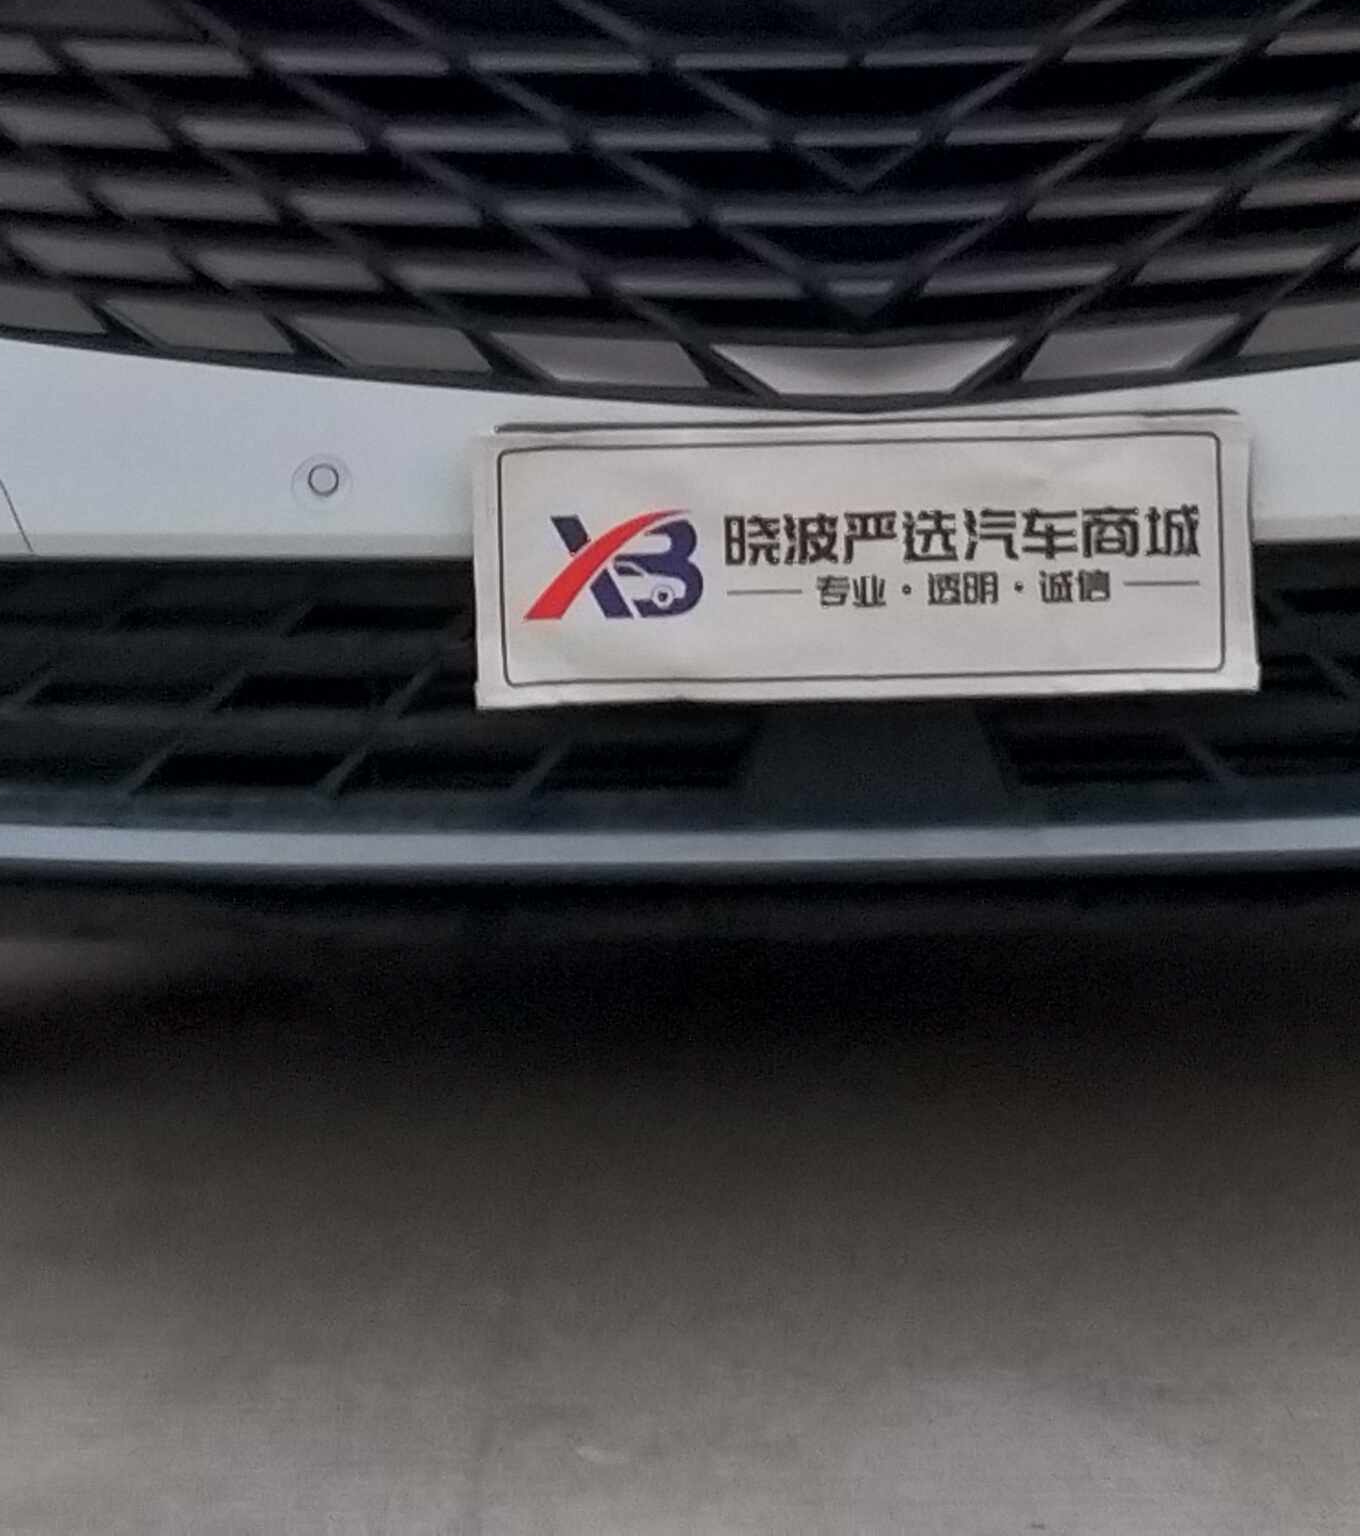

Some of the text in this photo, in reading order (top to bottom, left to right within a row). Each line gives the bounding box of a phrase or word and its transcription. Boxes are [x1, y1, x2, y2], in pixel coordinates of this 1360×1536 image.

[724, 504, 1202, 565] 晓波严选汽车商城
